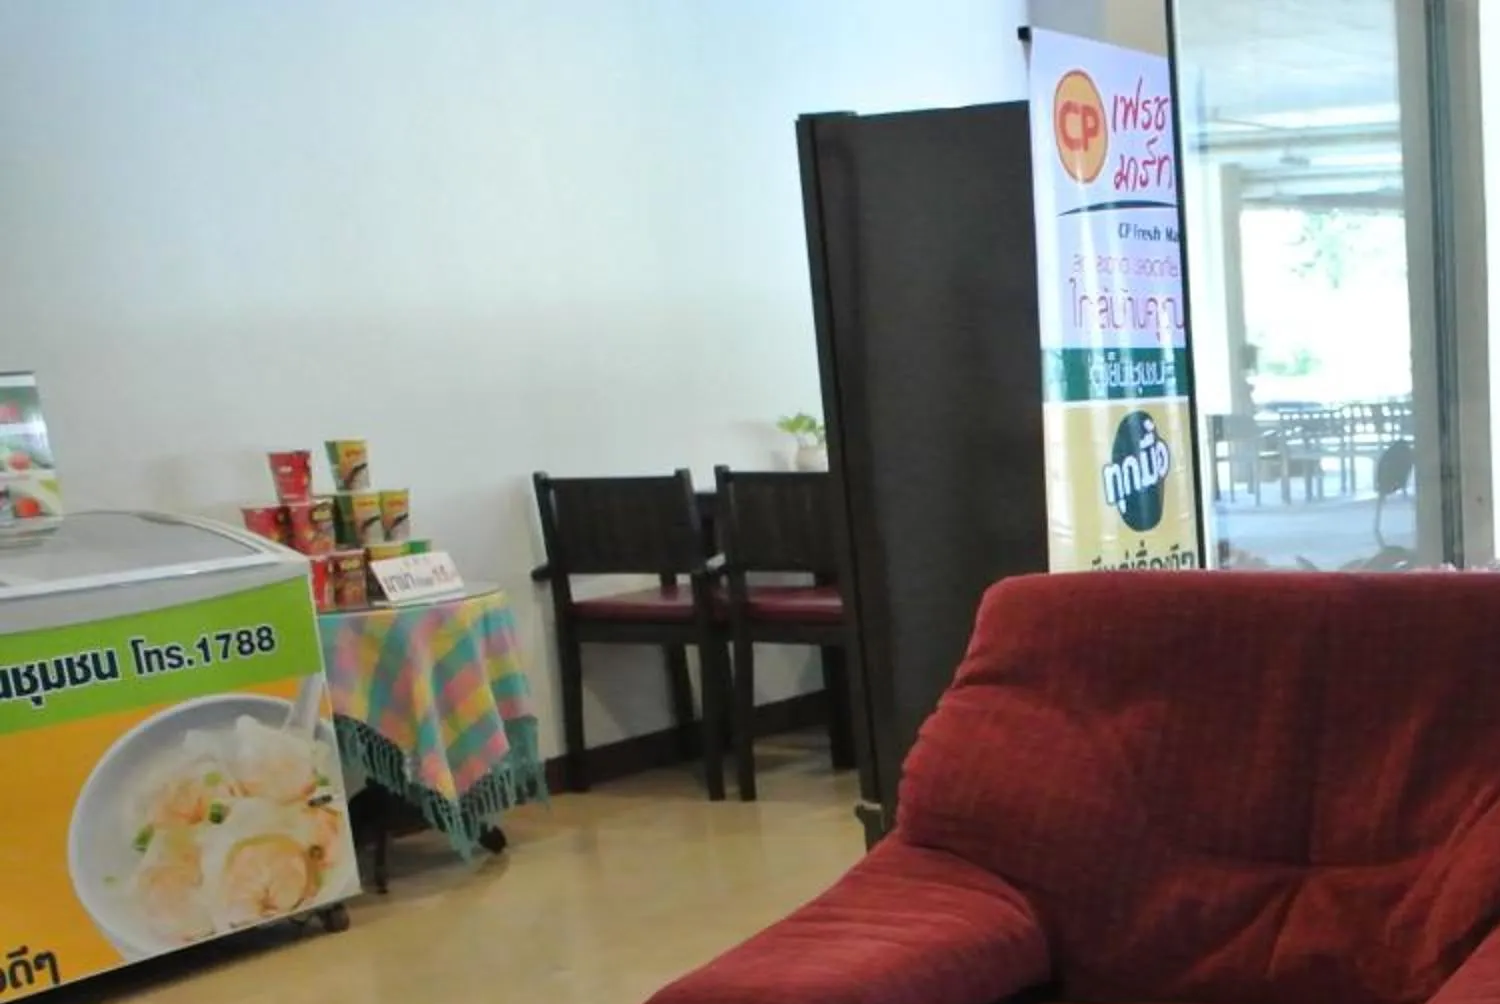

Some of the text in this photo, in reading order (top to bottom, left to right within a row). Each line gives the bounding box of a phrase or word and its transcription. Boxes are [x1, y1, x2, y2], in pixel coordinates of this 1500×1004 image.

[1059, 101, 1099, 152] CP
[1133, 223, 1161, 241] Fresh
[131, 626, 275, 675] โทร.1788
